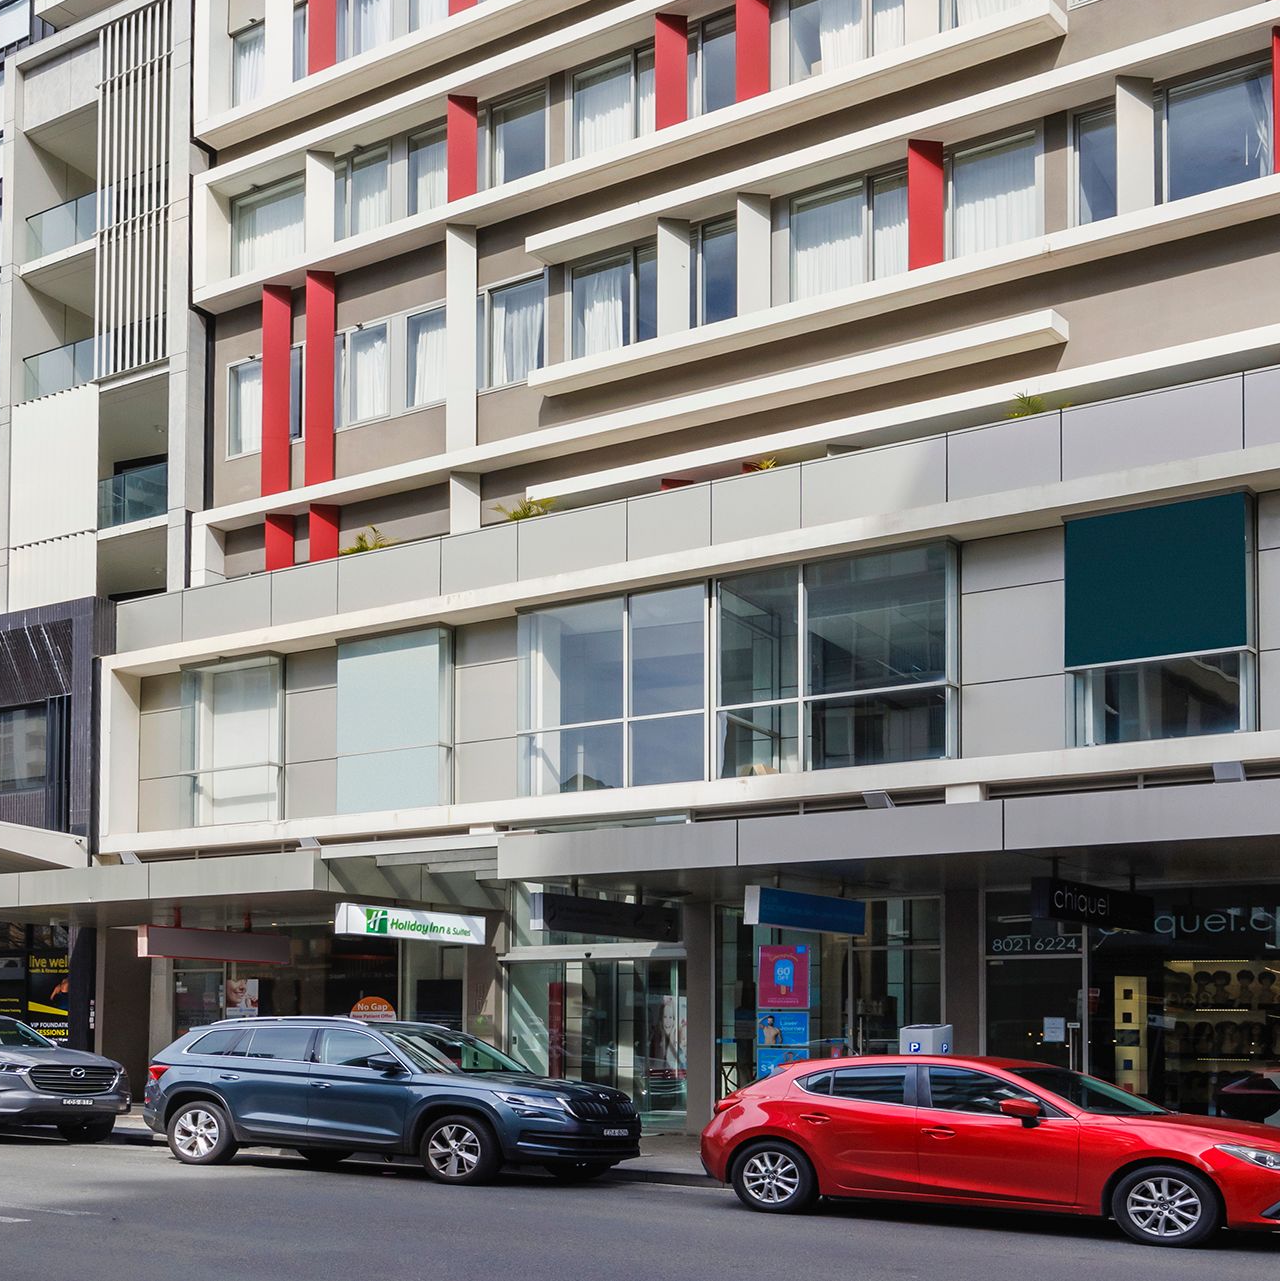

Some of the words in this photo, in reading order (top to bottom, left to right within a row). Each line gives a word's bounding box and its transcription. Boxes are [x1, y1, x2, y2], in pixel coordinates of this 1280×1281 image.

[1054, 885, 1110, 917] chiquel
[452, 927, 471, 937] Suites
[992, 937, 1077, 952] 80216224
[29, 955, 47, 968] live
[48, 955, 69, 968] wel
[776, 967, 791, 976] 60
[371, 1003, 388, 1012] Gap
